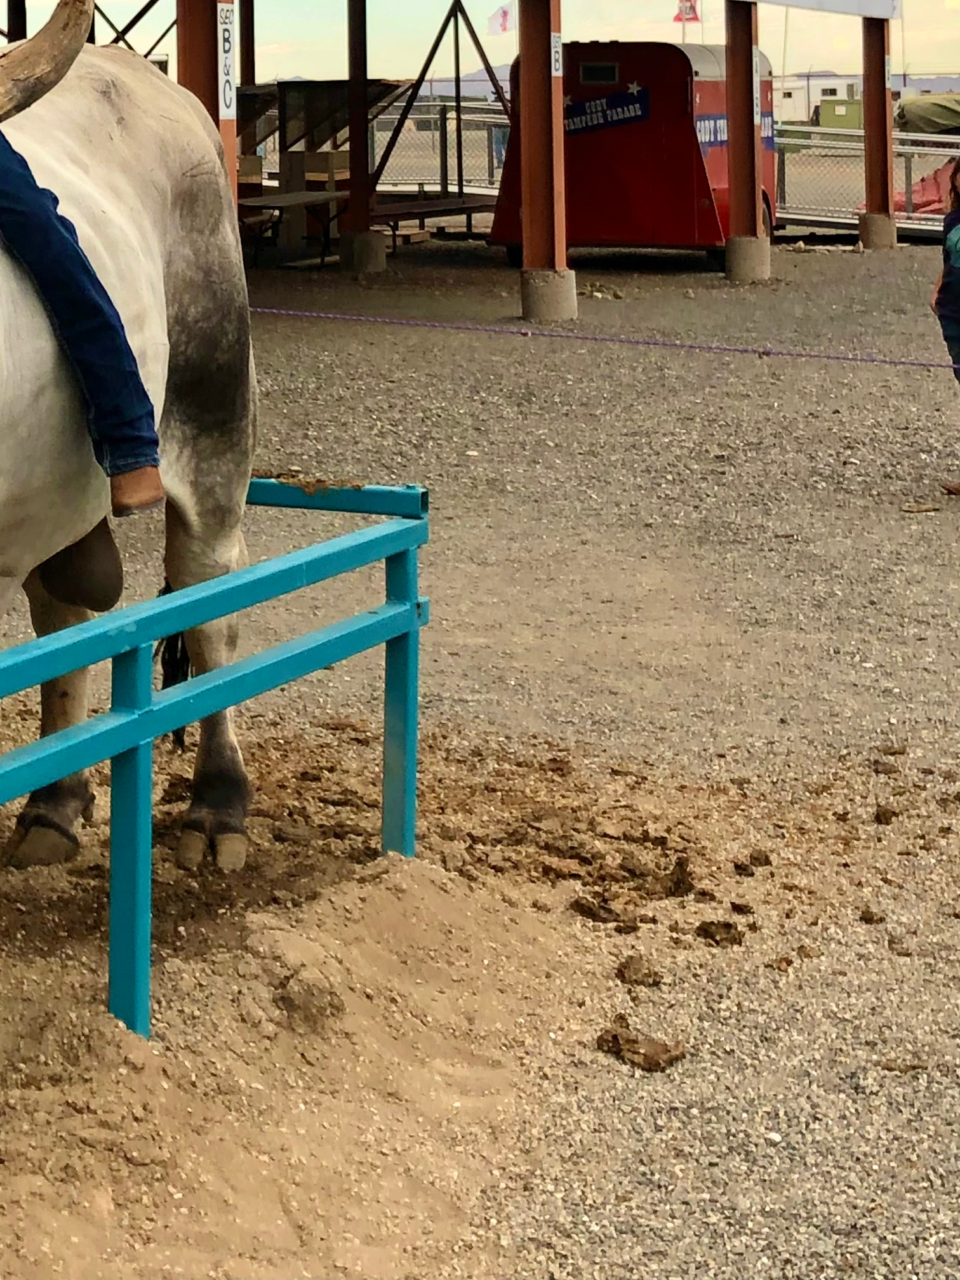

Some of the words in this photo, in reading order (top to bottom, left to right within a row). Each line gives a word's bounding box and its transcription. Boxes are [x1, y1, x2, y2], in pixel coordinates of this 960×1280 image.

[222, 28, 231, 54] B
[223, 79, 232, 109] C
[564, 109, 604, 131] TAMPEDE
